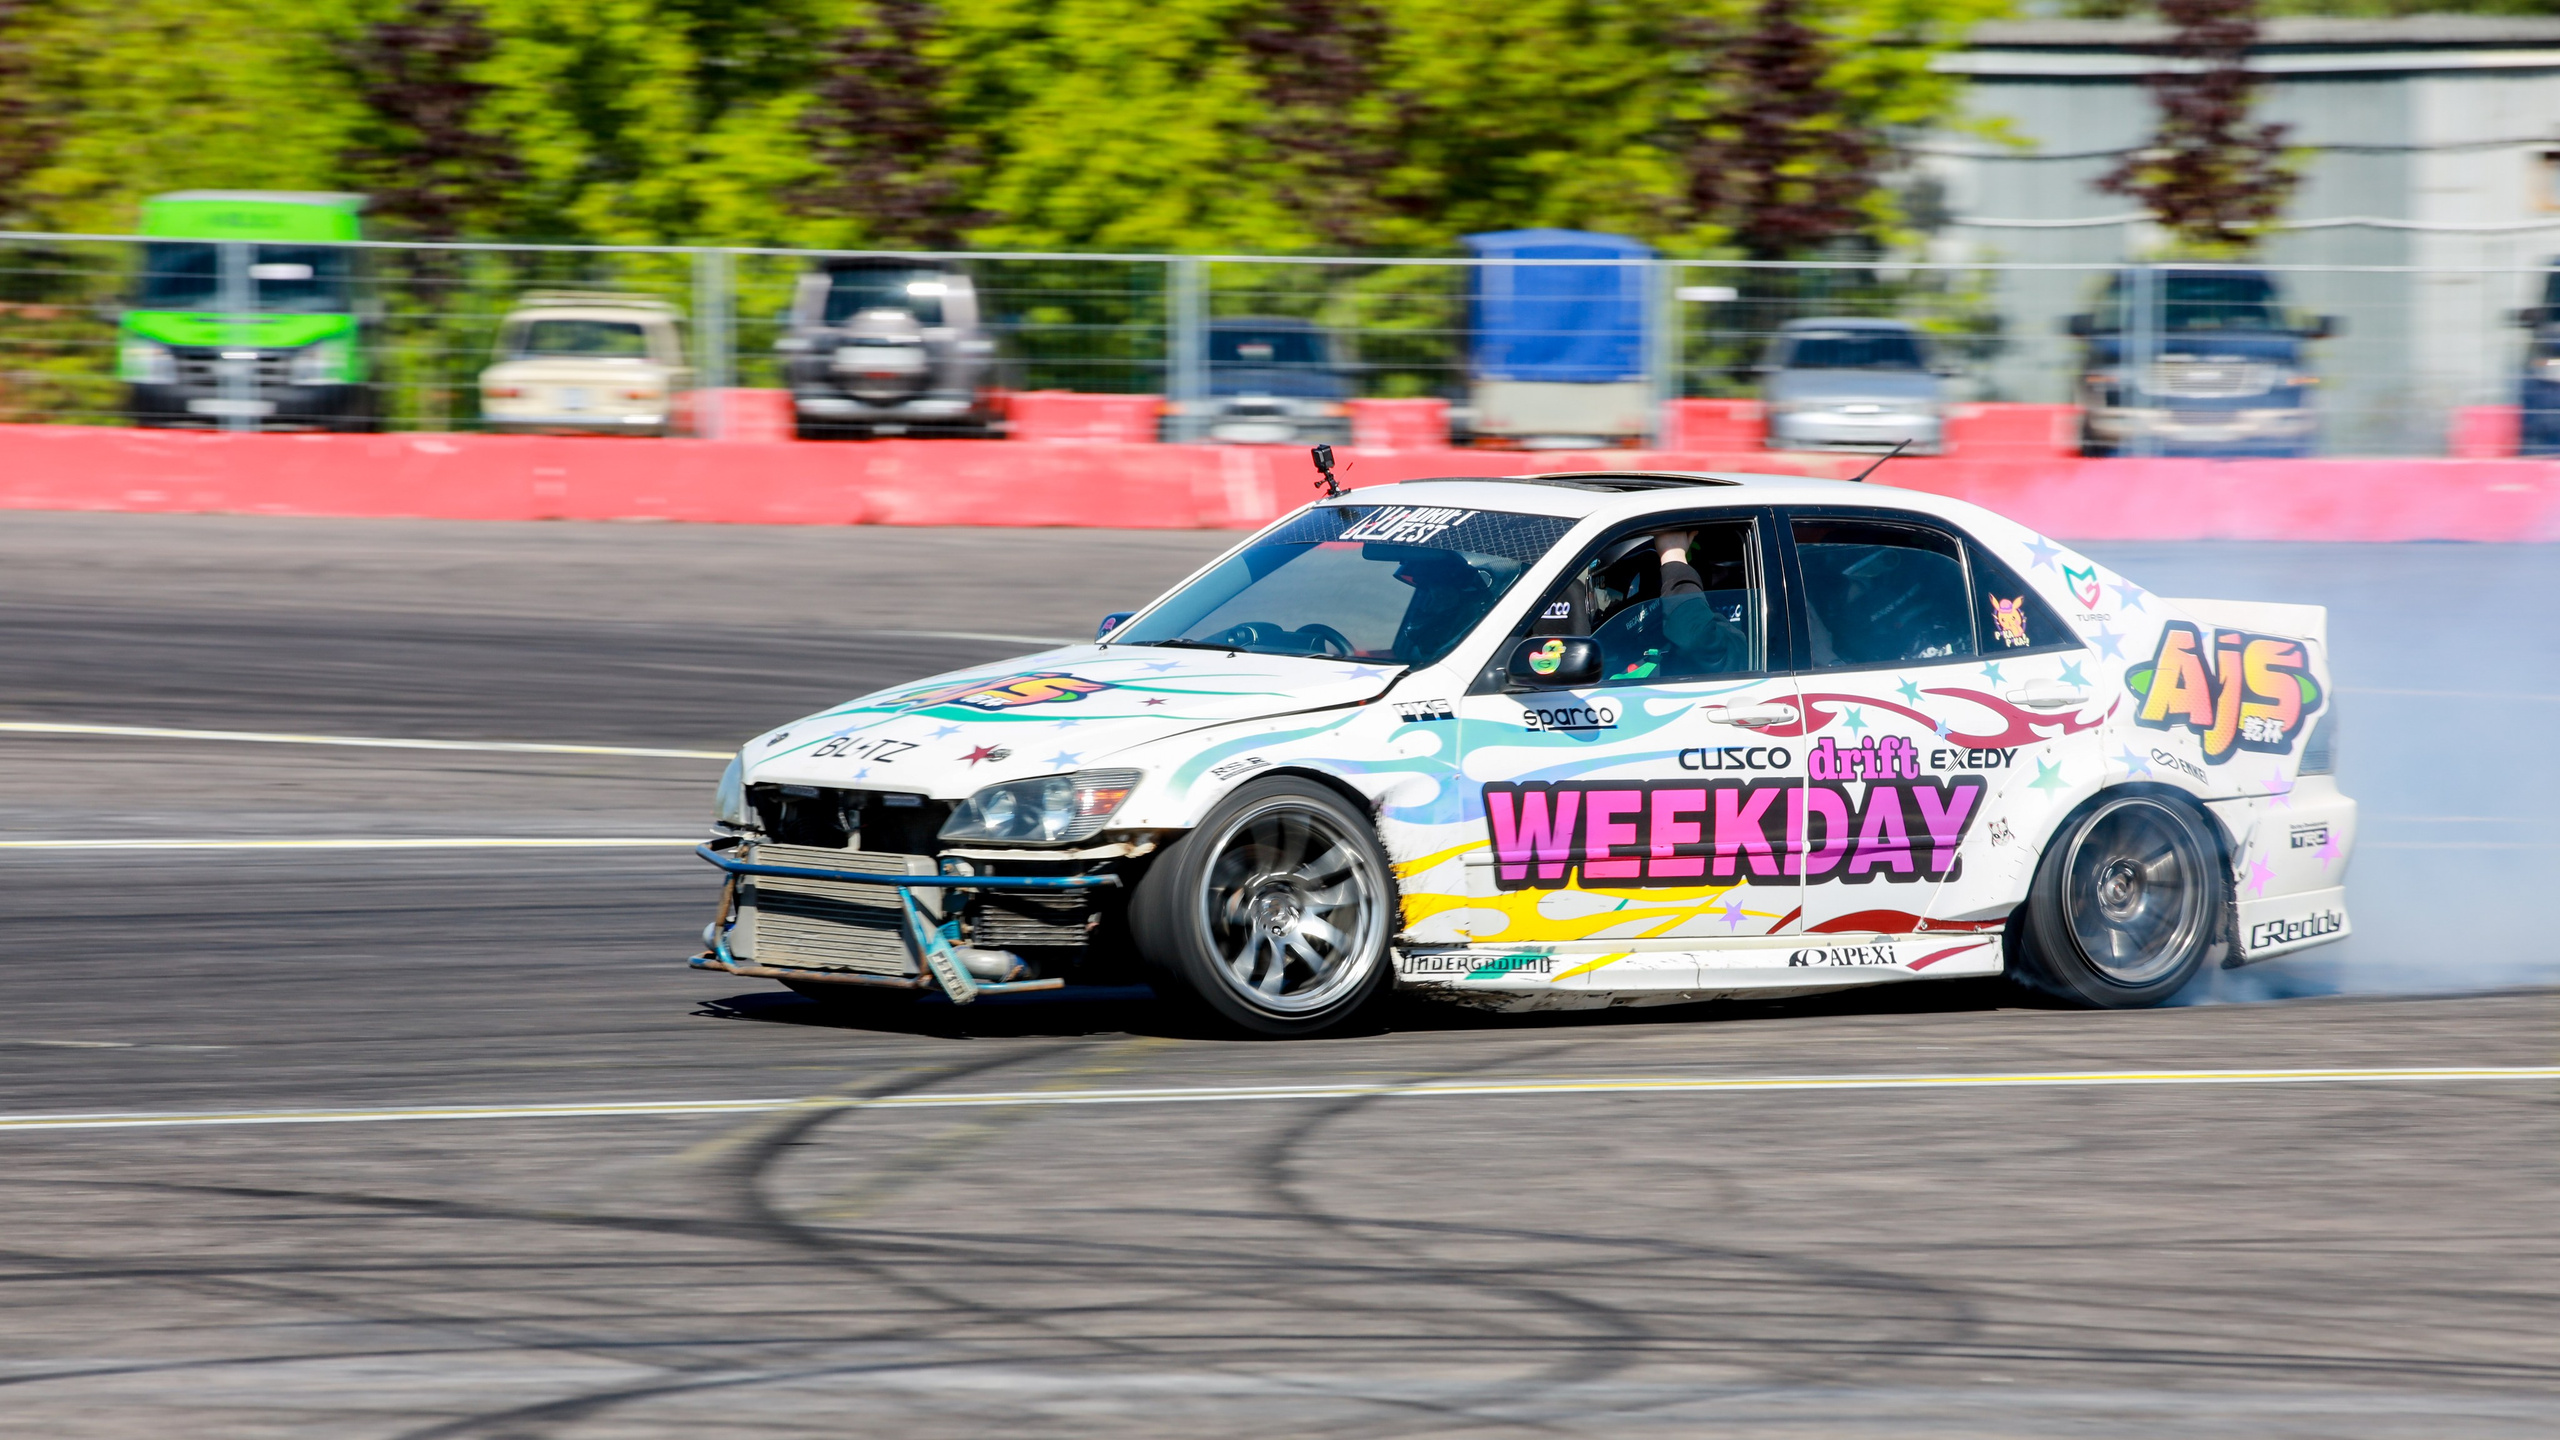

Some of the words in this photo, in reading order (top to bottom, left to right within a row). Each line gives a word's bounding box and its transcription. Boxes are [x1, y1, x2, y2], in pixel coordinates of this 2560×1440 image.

[1391, 523, 1450, 543] FEST
[2076, 613, 2111, 622] TURBO
[1393, 698, 1455, 722] HKS
[1523, 706, 1615, 732] sparco
[1678, 746, 1792, 771] CUSCO
[1808, 737, 1919, 780] drift
[1929, 747, 2019, 772] EXEDY
[1487, 784, 1981, 881] WEEKDAY
[2250, 908, 2342, 950] GReddy
[1402, 954, 1549, 973] UNDERGROUND
